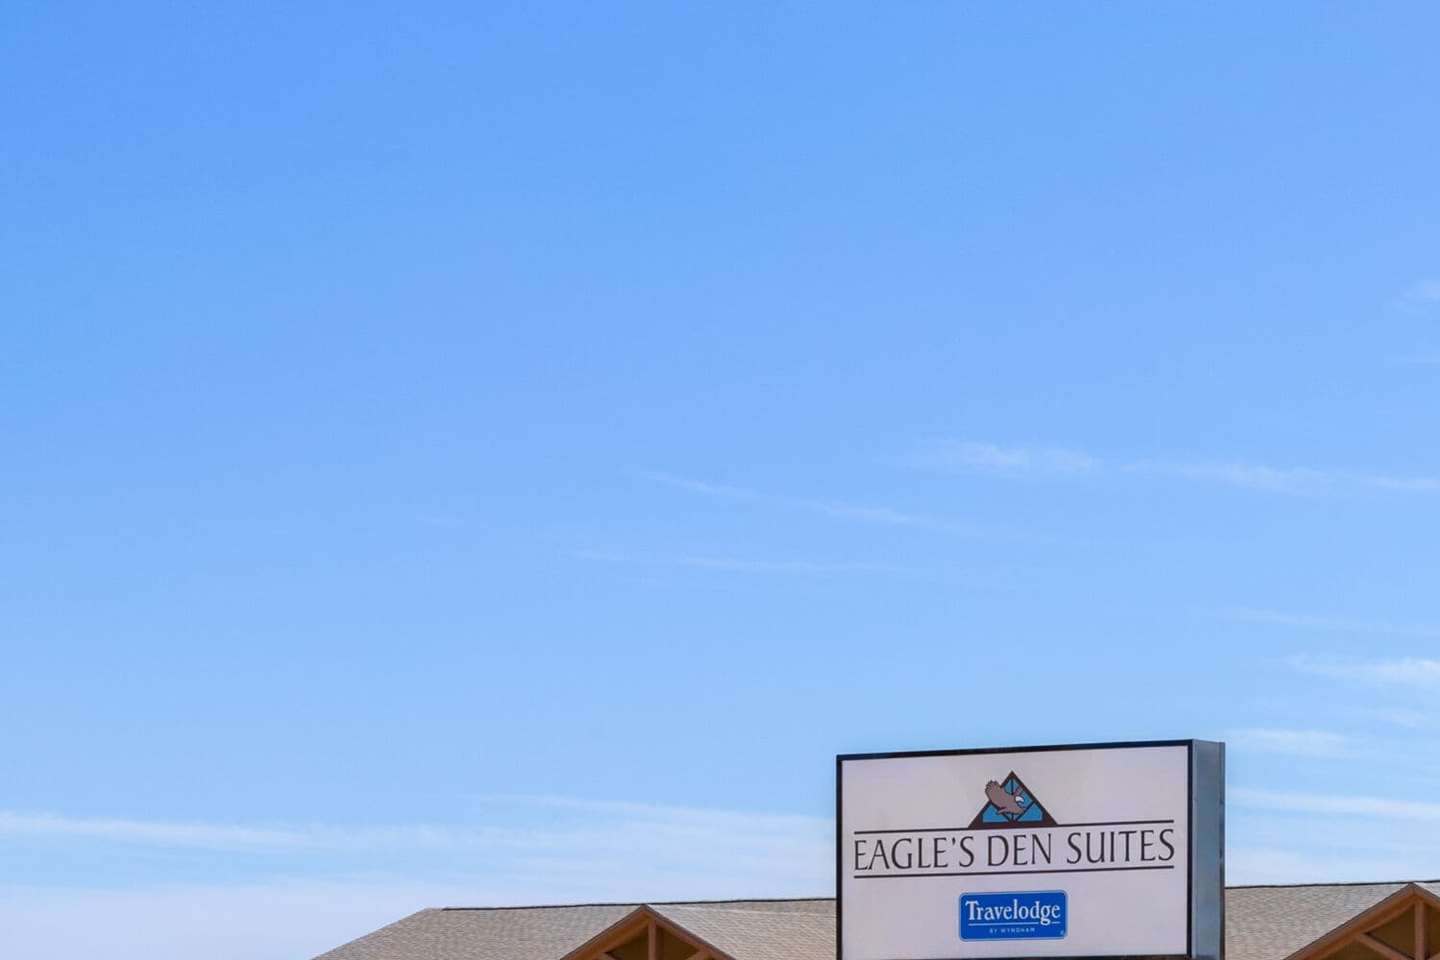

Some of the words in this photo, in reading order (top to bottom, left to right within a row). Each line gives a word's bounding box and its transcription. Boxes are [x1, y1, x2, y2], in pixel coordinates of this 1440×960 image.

[854, 836, 974, 871] EAGLE'S
[987, 833, 1051, 866] DEN
[1067, 829, 1175, 864] SUITES
[965, 899, 1061, 926] Travelodge
